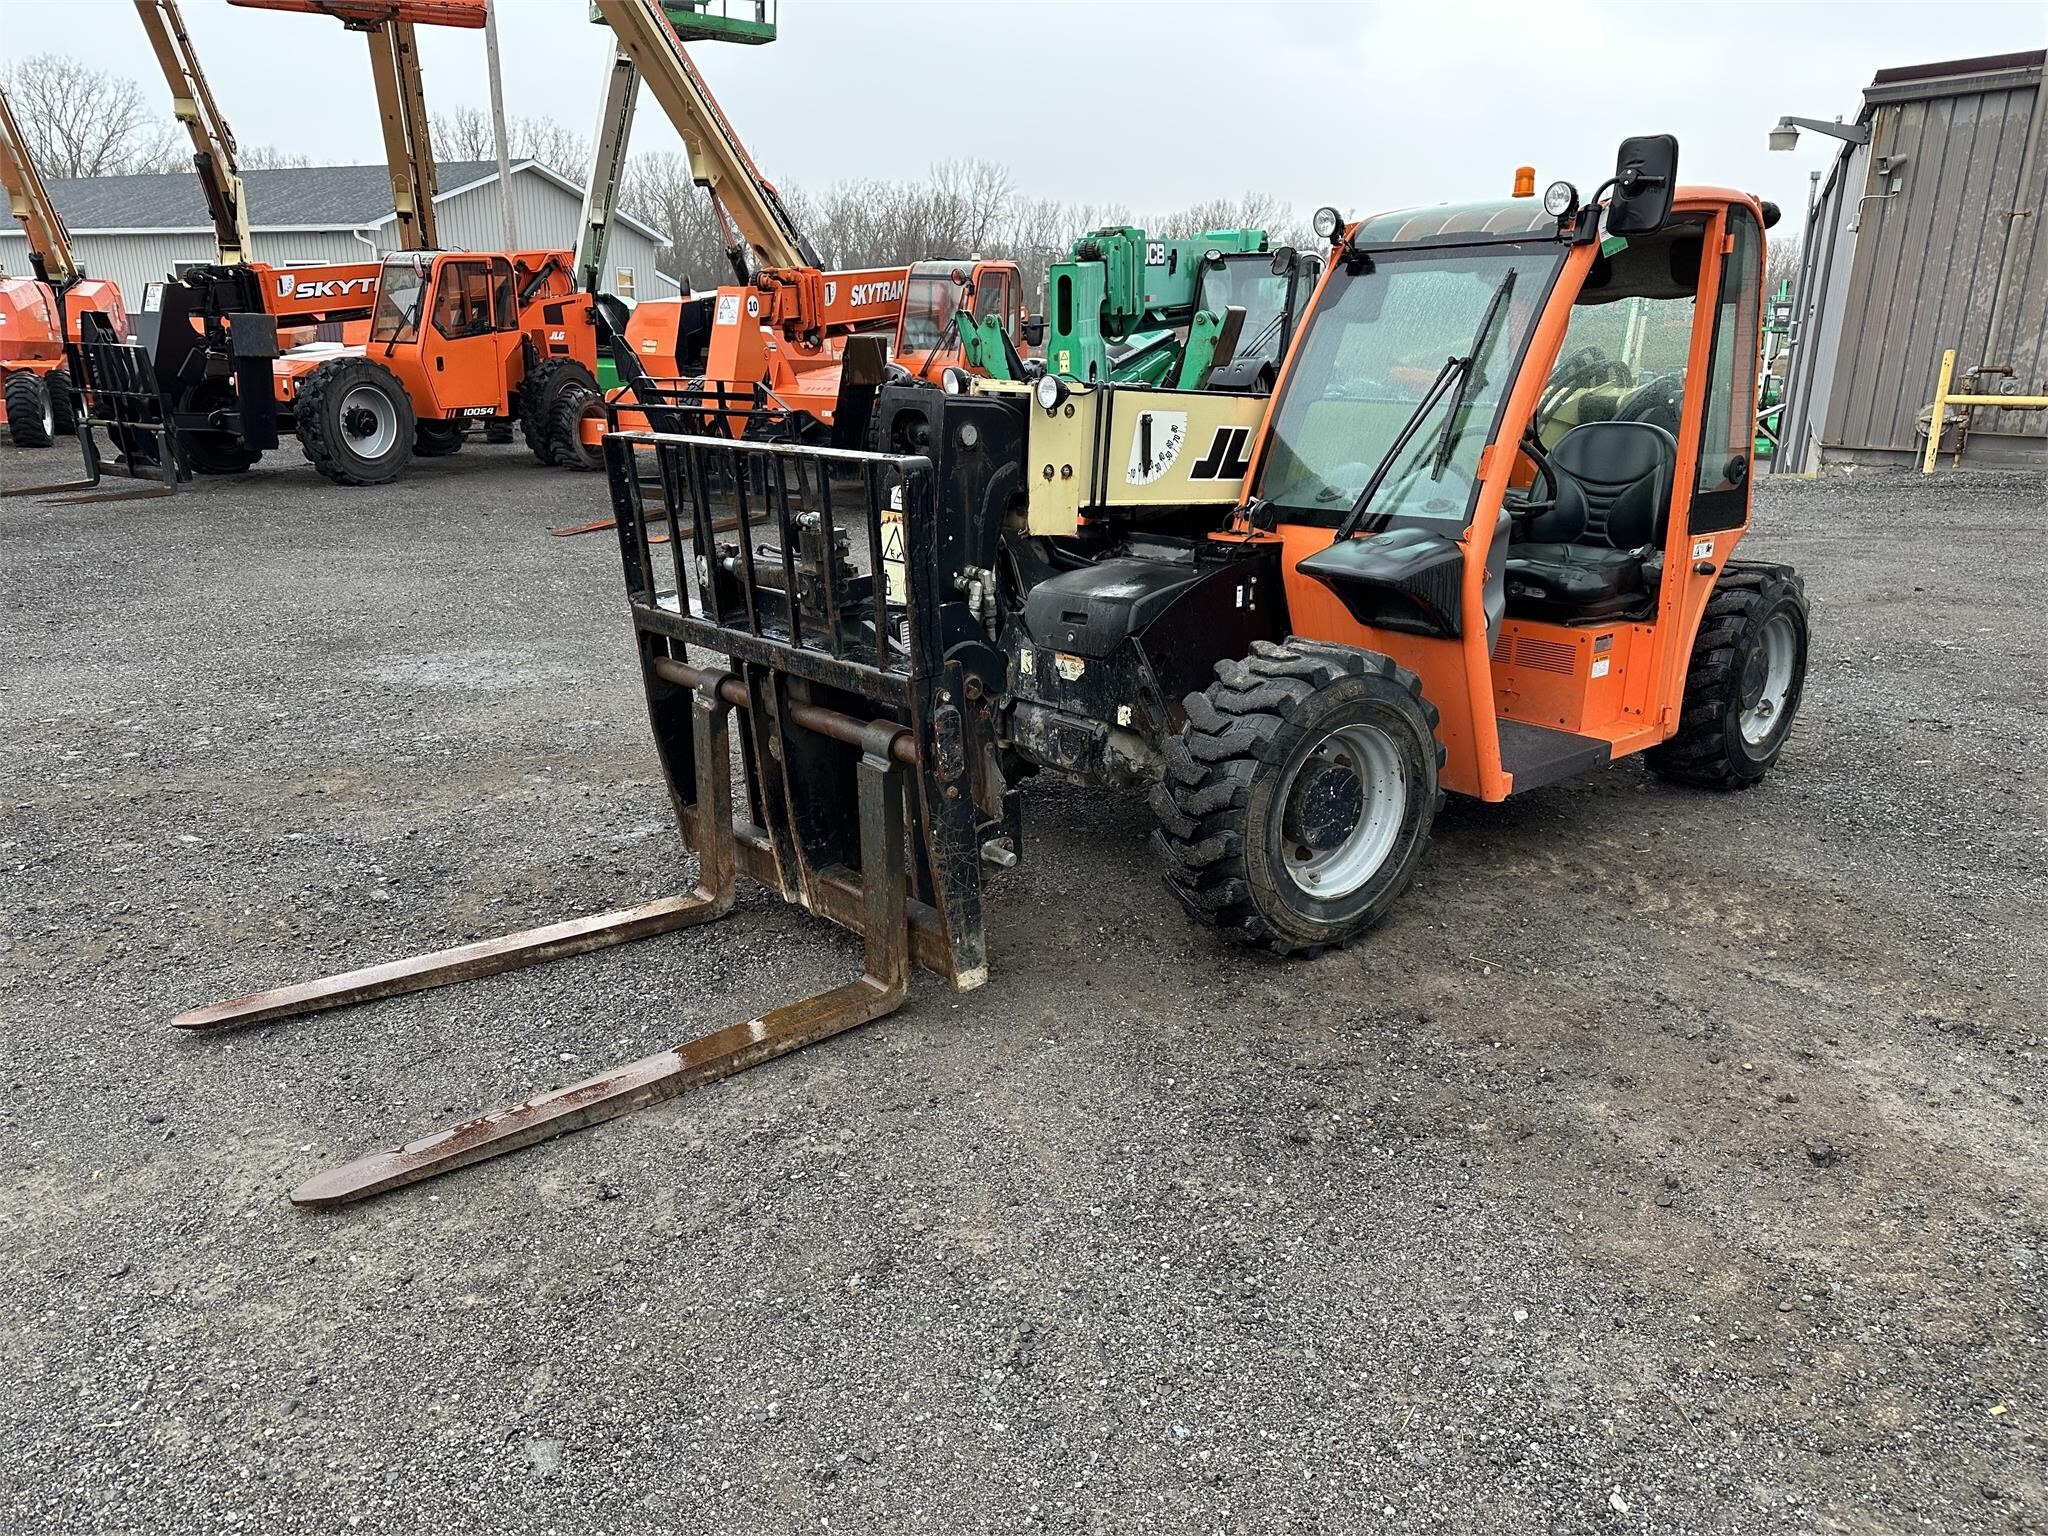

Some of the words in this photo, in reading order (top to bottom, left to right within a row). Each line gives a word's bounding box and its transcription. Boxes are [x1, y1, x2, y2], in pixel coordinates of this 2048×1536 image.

[850, 280, 904, 306] SKYTRAK
[748, 300, 758, 312] 10
[549, 331, 566, 340] JLG
[463, 407, 494, 416] 10054
[1170, 424, 1179, 434] 80
[1172, 434, 1181, 444] 70
[1187, 425, 1253, 481] JL
